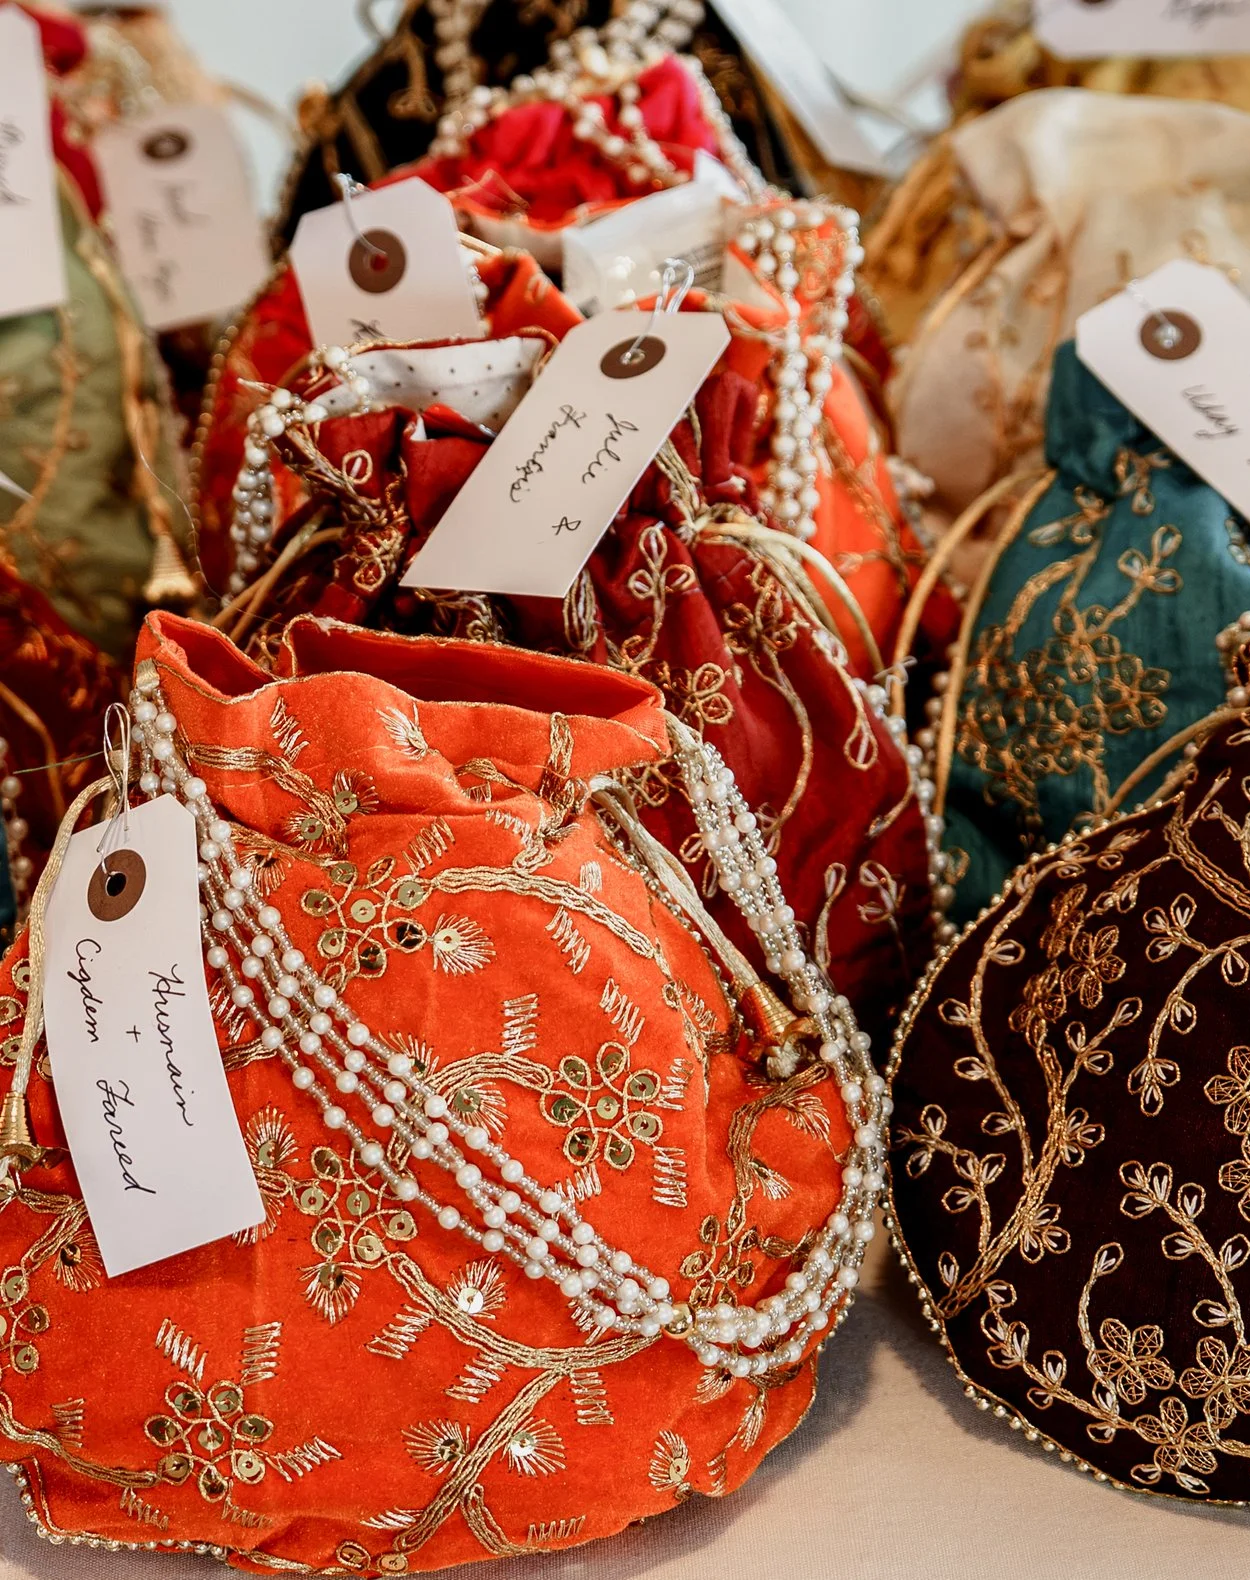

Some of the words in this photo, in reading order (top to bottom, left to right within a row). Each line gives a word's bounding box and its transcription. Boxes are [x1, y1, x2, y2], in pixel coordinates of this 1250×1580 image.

[582, 413, 639, 484] Julie
[67, 939, 103, 1042] Cigdem
[97, 1079, 156, 1194] Fareed
[149, 964, 194, 1126] Husnain
